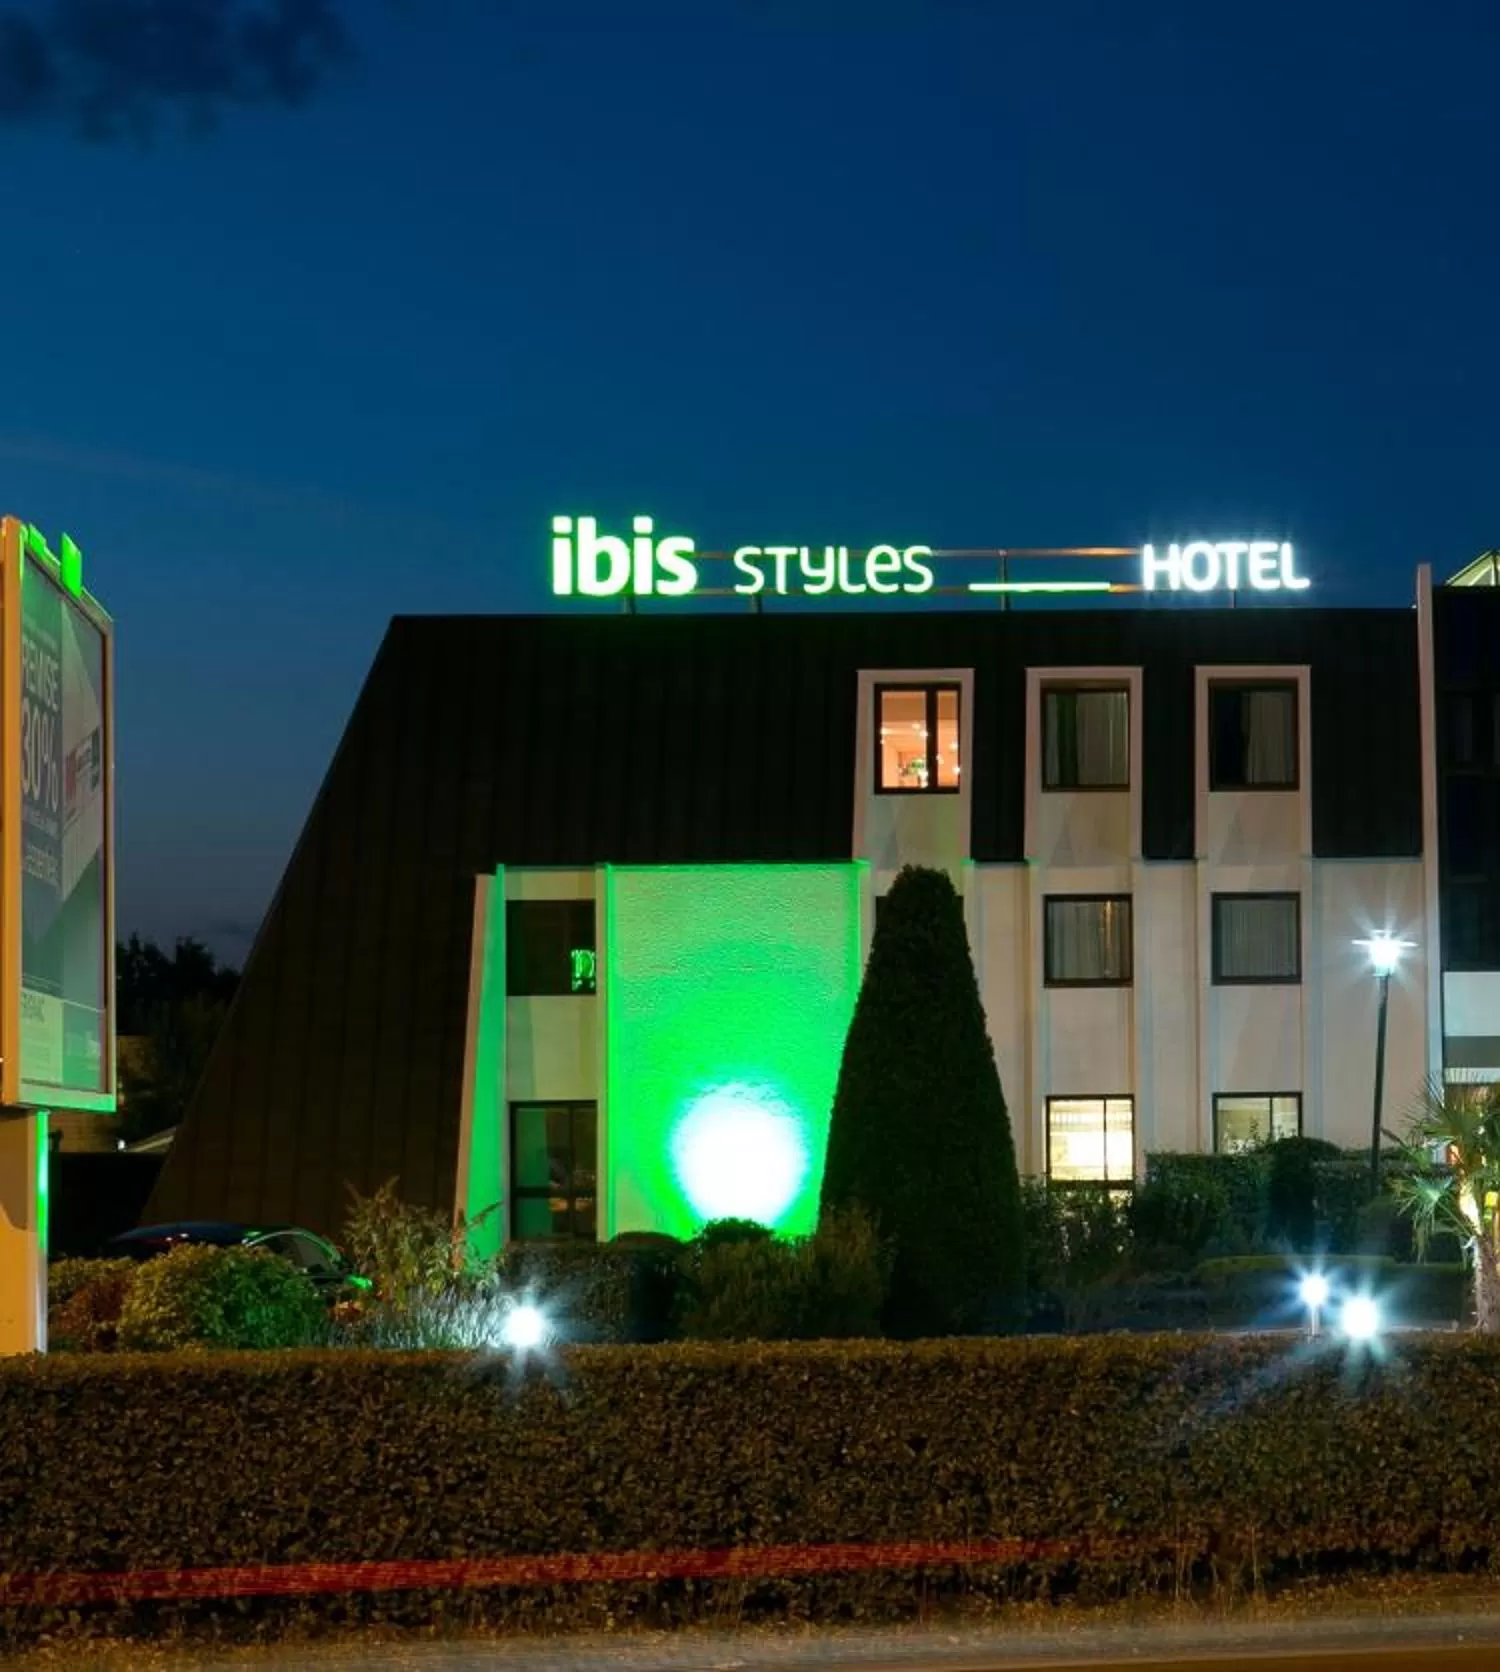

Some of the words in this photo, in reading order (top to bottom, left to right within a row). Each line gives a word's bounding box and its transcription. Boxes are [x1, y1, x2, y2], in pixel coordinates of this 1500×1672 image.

[552, 515, 698, 596] ibis
[1142, 541, 1312, 592] HOTEL
[22, 697, 60, 813] 30%
